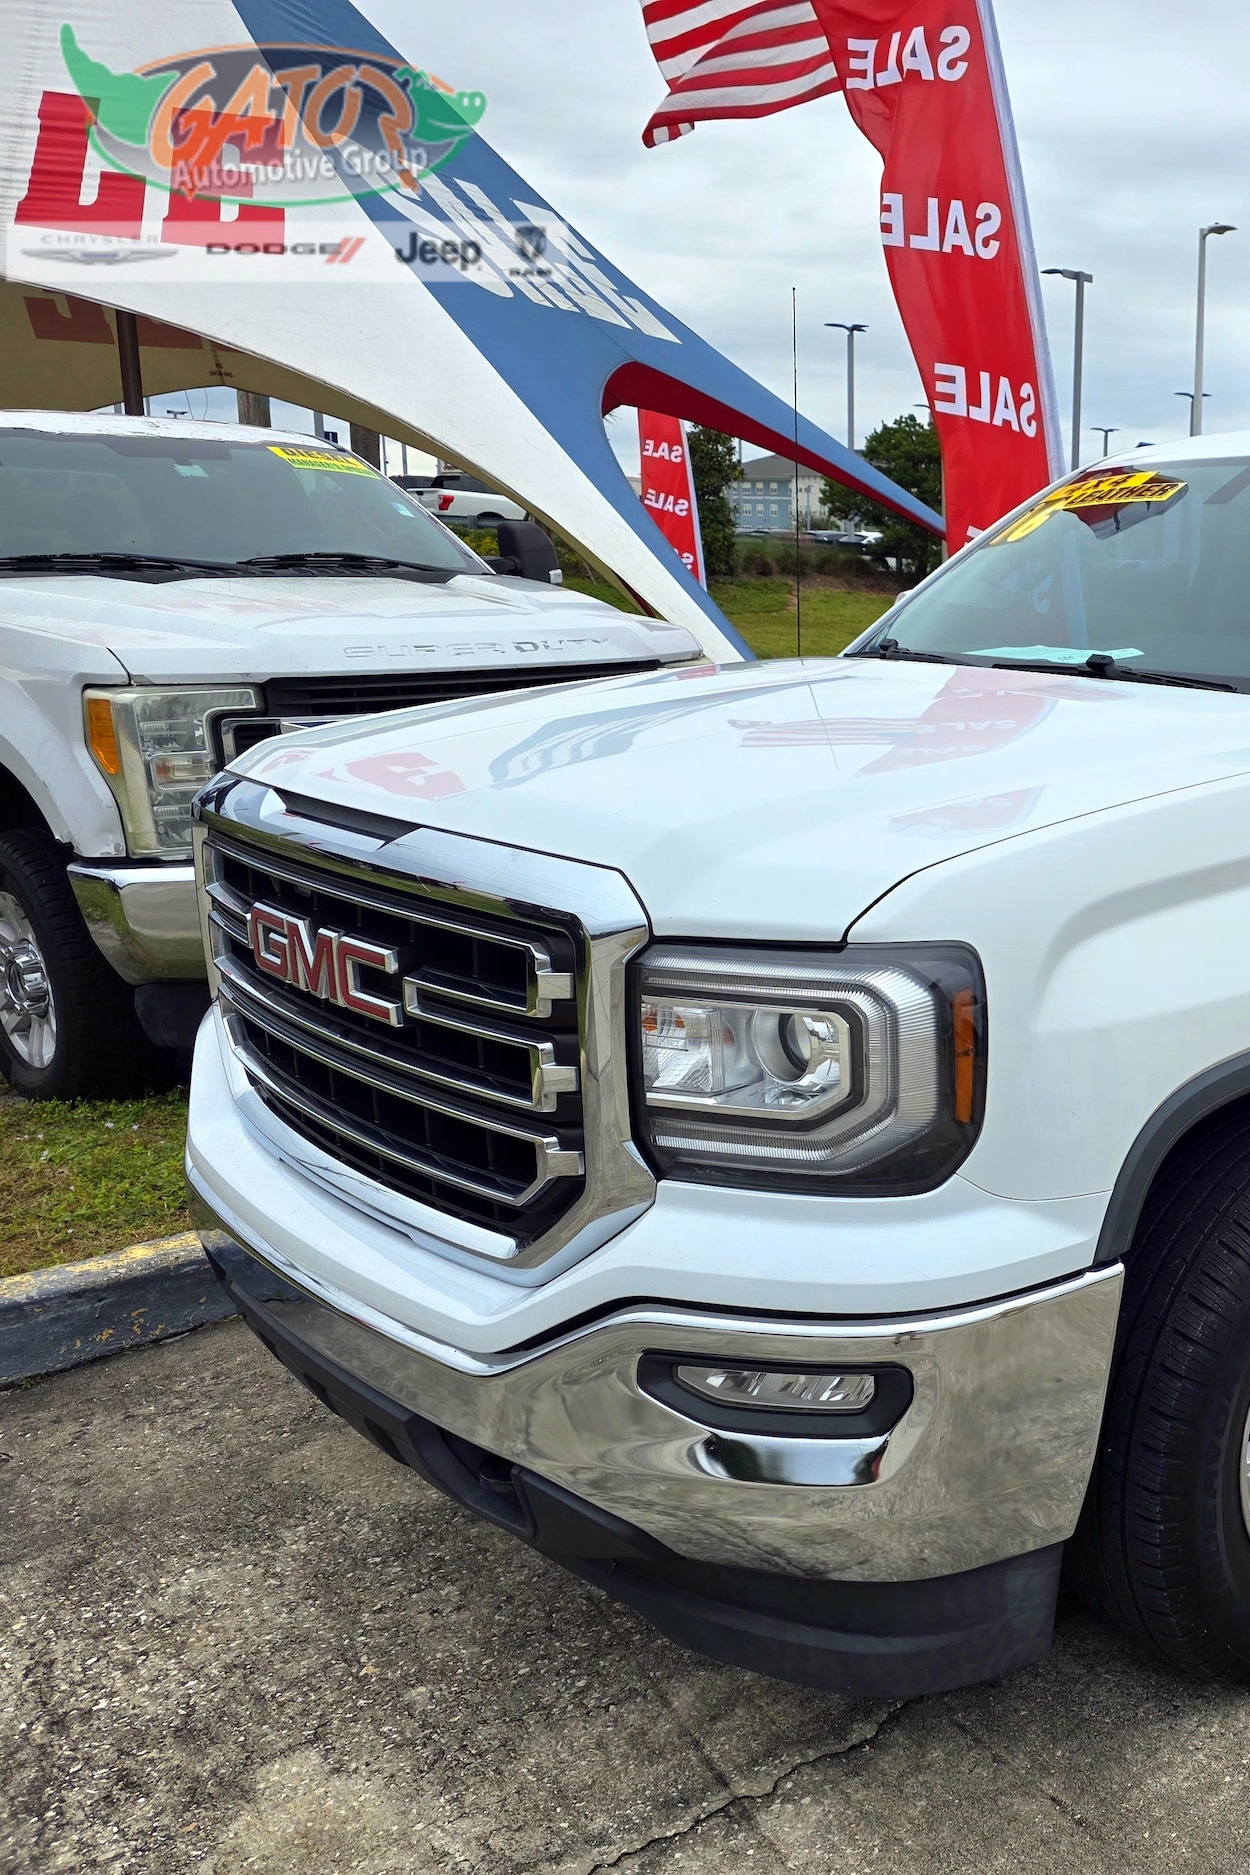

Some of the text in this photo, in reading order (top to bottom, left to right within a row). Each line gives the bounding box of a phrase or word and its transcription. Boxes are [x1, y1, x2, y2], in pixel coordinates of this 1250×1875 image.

[1065, 483, 1178, 506] LEATHER
[343, 637, 611, 659] SUPER DUTY
[251, 901, 404, 1028] GMC
